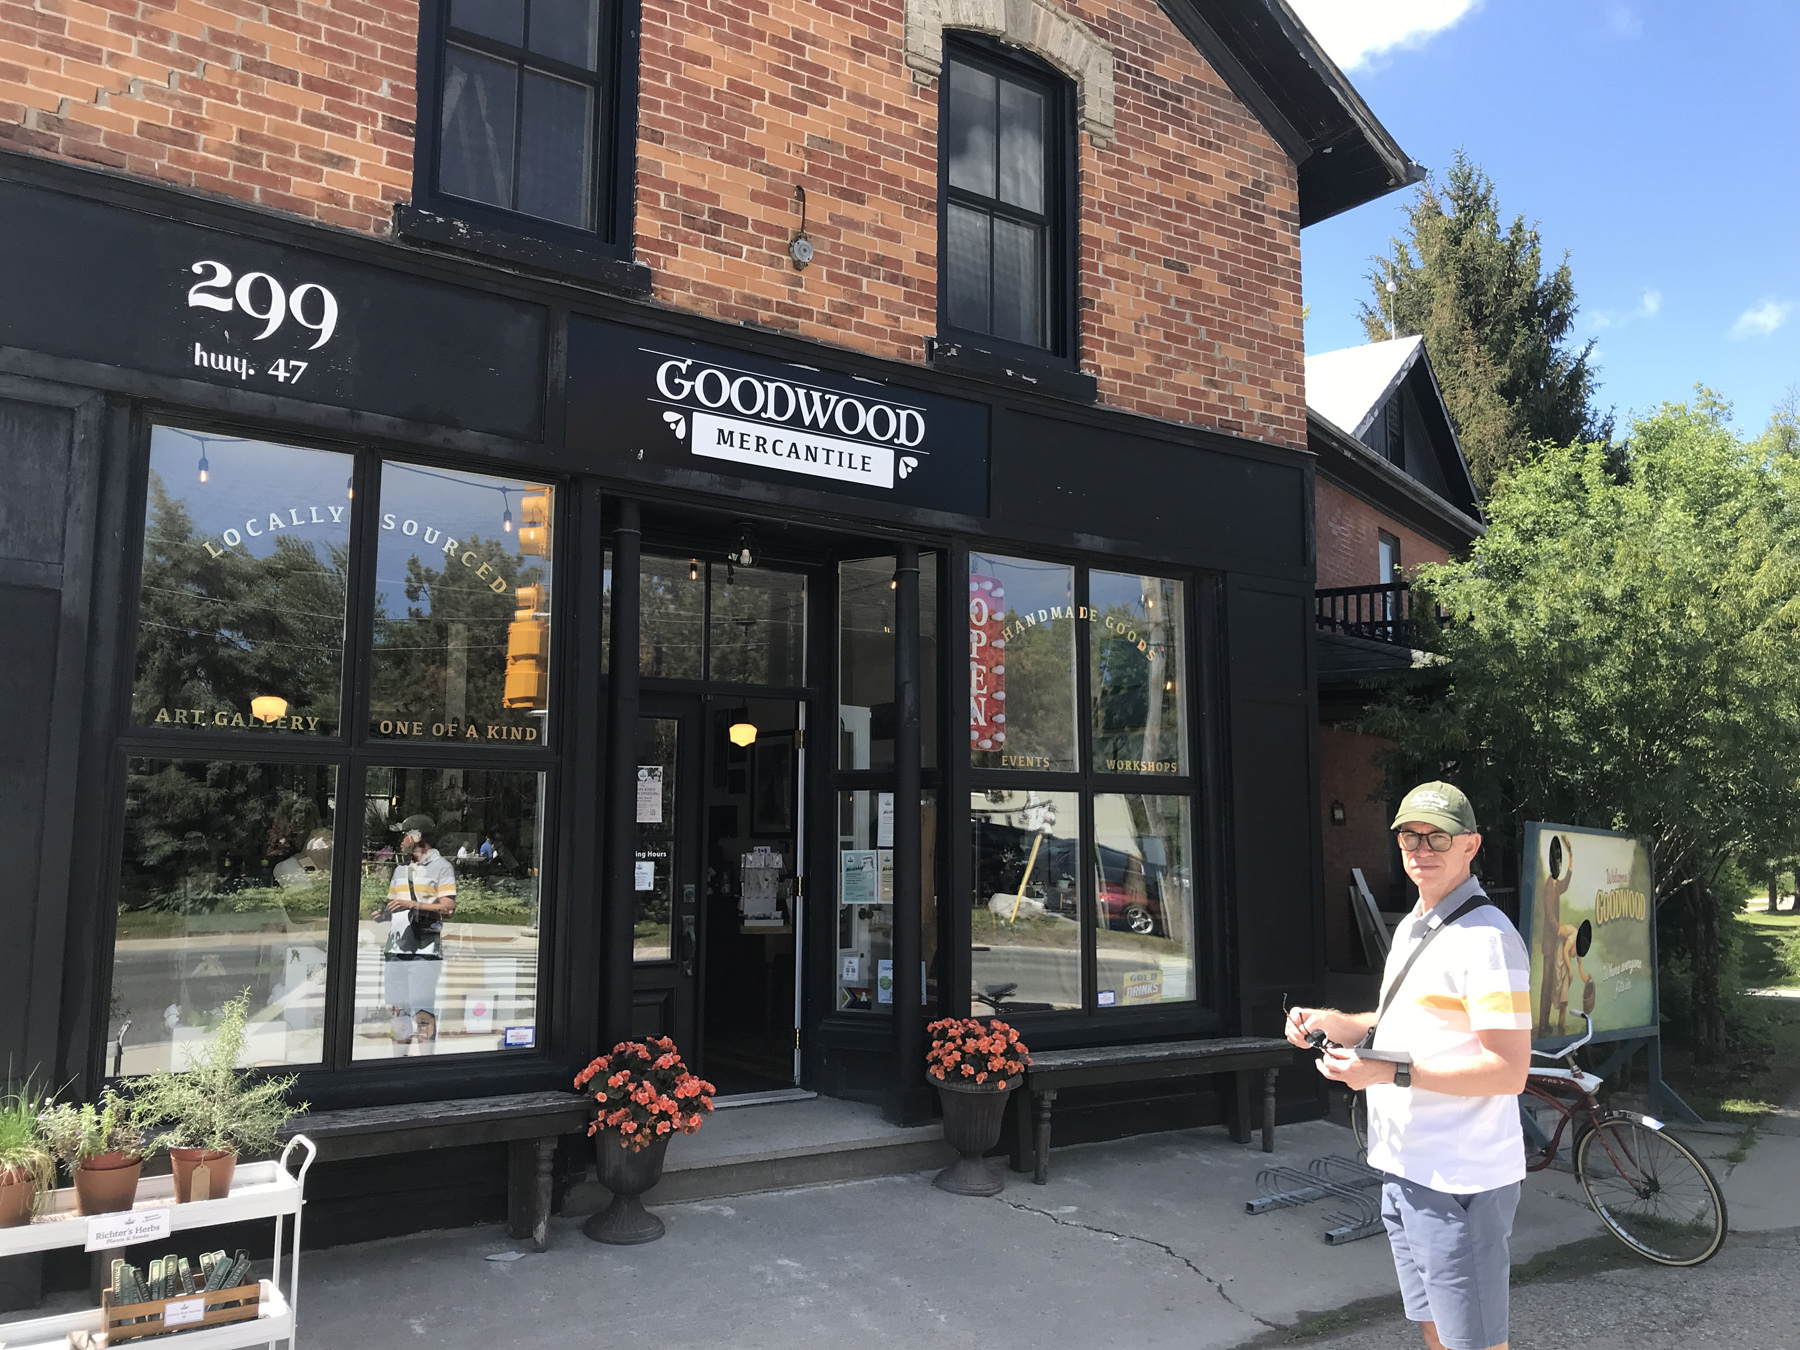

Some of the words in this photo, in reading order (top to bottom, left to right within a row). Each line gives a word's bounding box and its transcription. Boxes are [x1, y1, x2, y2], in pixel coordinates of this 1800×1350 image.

[187, 260, 339, 350] 299
[194, 342, 256, 381] hwy.
[267, 357, 309, 385] 47
[656, 359, 926, 447] GOODWOOD
[716, 428, 872, 473] MERCANTILE
[202, 506, 346, 560] LOCALLY
[382, 513, 508, 595] SOURCED
[1001, 606, 1098, 643] HANDMADE
[1105, 616, 1156, 662] GOODS
[970, 598, 989, 727] OPEN
[154, 708, 205, 725] ART
[214, 711, 320, 731] GALLERY
[379, 720, 424, 736] ONE
[432, 722, 458, 737] OF
[465, 724, 479, 738] A
[487, 725, 538, 741] KIND
[1001, 756, 1050, 768] EVENTS
[1106, 759, 1178, 773] WORKSHOPS
[647, 850, 667, 858] Hours
[1595, 888, 1646, 925] GOODWOOD
[1127, 982, 1159, 998] DRINKS
[95, 1227, 133, 1240] Richter's
[135, 1224, 161, 1234] Herbs
